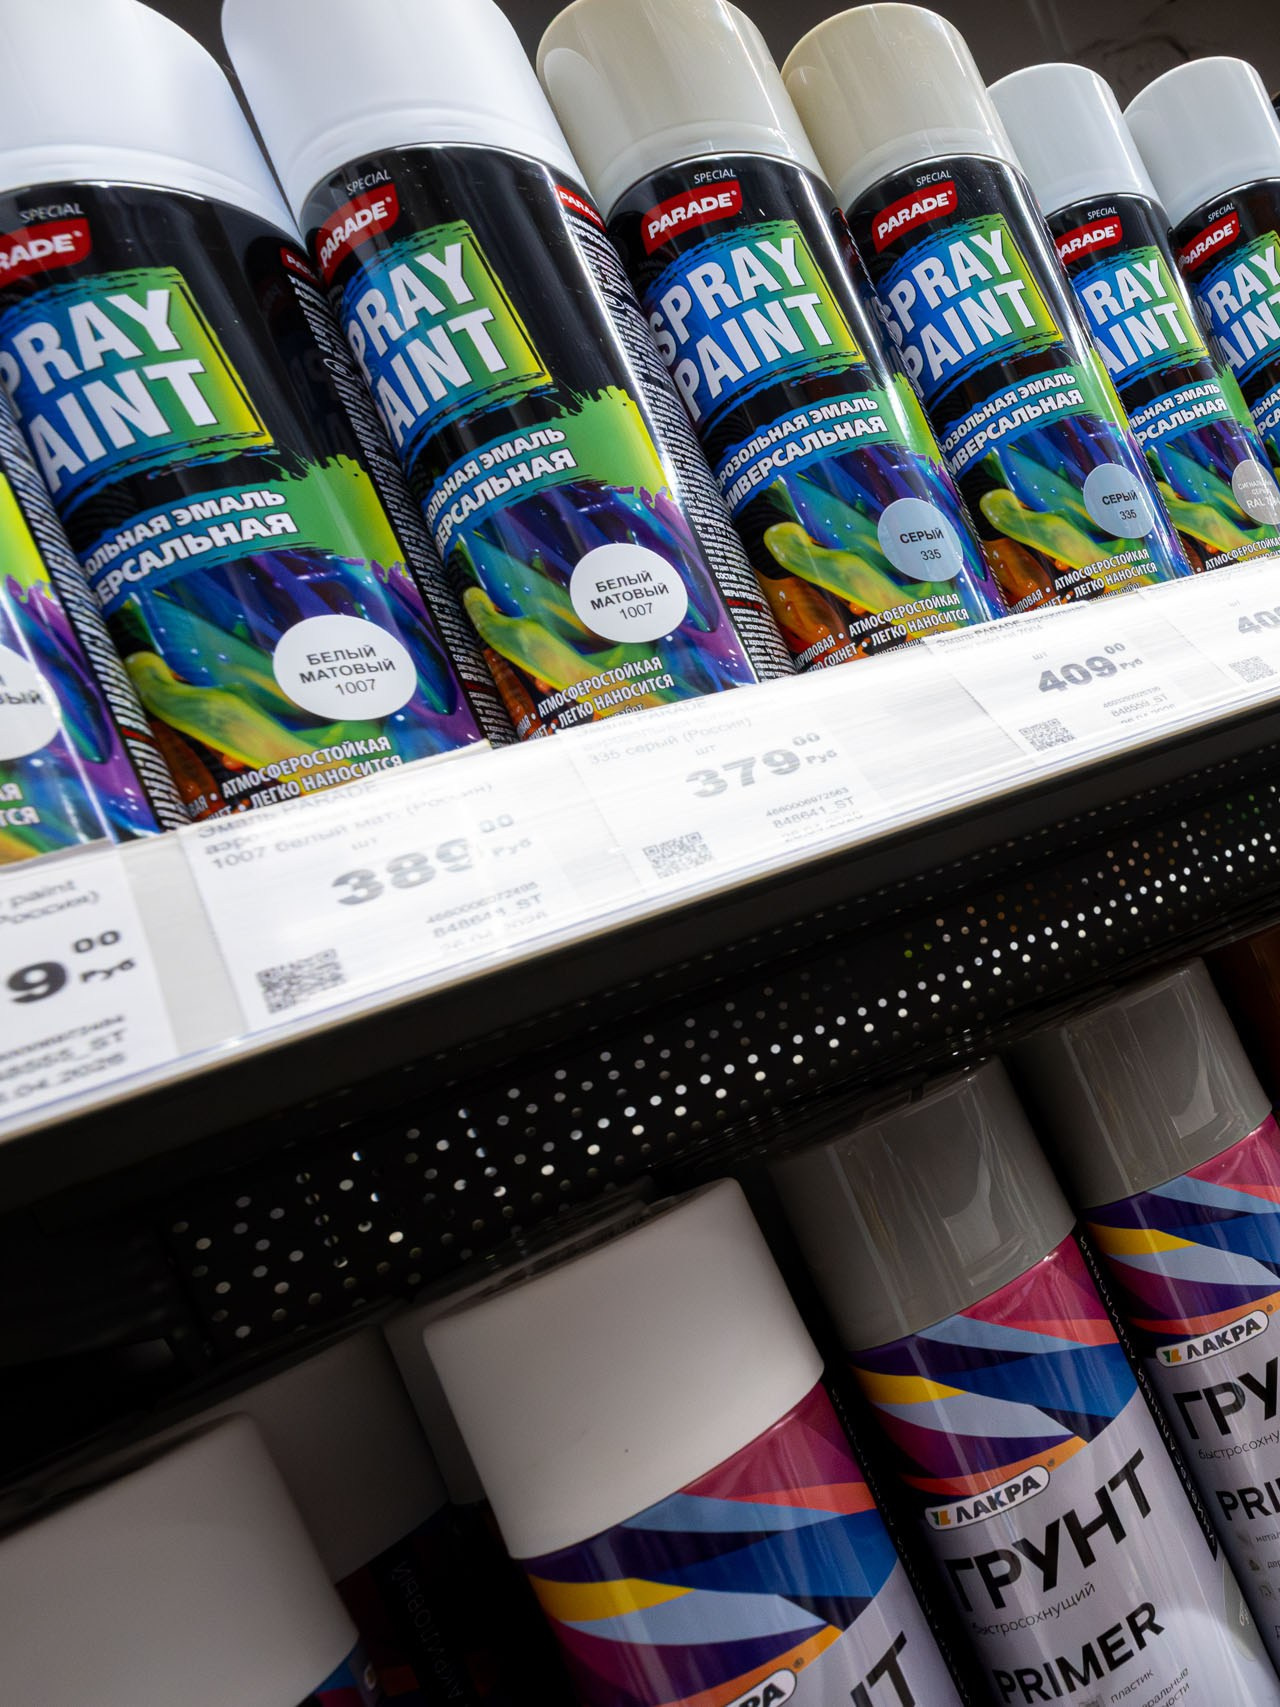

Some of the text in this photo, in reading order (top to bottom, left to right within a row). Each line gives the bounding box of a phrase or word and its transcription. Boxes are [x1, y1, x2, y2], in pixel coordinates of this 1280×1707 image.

[345, 169, 392, 197] SPECIAL
[694, 168, 736, 185] SPECIAL
[916, 170, 952, 187] SPECIAL
[20, 203, 84, 223] SPECIAL
[648, 191, 734, 240] PARADE
[877, 192, 949, 239] PARADE
[1087, 207, 1118, 220] SPECIAL
[1208, 202, 1236, 223] SPECIAL
[319, 200, 390, 267] PARADE
[649, 237, 806, 362] SPRAY
[1082, 259, 1168, 326] RAY
[674, 292, 833, 422] PAINT
[903, 279, 1036, 398] PAINT
[378, 307, 508, 449] AINT
[1018, 371, 1076, 399] ЭМАЛЬ
[1175, 384, 1222, 405] ЭМАЛЬ
[28, 358, 219, 494] AINT
[811, 396, 879, 425] ЭМАЛЬ
[482, 428, 567, 467] ЭМАЛЬ
[174, 489, 287, 526] ЭМАЛЬ
[1101, 490, 1139, 507] СЕРЫЙ
[1119, 508, 1137, 521] 335
[899, 526, 944, 545] СЕРЫЙ
[920, 548, 942, 561] 335
[595, 570, 653, 593] БЕЛЫЙ
[1054, 548, 1150, 591] АТМОСФЕРОСТОЙКАЯ
[1074, 580, 1104, 600] ЛЕГКО
[1104, 561, 1158, 585] НАНОСИТСЯ
[590, 584, 669, 611] МАТОВЫЙ
[618, 602, 654, 620] 1007
[848, 593, 960, 639] АТМОСФЕРОСТОЙКАЯ
[871, 607, 970, 648] ЛЕГКО НАНОСИТСЯ
[299, 657, 397, 686] МАТОВЫЙ
[306, 644, 377, 666] БЕЛЫЙ
[1037, 642, 1127, 694] 409 00
[334, 678, 377, 697] 1007
[537, 656, 663, 718] АТМОСФЕРОСТОЙКАЯ
[558, 702, 595, 729] ЛЕГКО
[594, 673, 675, 711] НАНОСИТСЯ
[222, 736, 392, 798] АТМОСФЕРОСТОЙКАЯ
[250, 780, 301, 810] ЛЕГКО
[301, 754, 402, 793] НАНОСИТСЯ
[684, 732, 821, 798] 379 00
[330, 837, 475, 907] 389
[70, 929, 123, 955] 00
[1187, 1316, 1263, 1360] ЛАКРА
[955, 1475, 1042, 1524] ЛАКРА
[944, 1448, 1153, 1614] ГРУНТ
[992, 1602, 1165, 1706] PRIMER
[1109, 1669, 1154, 1704] пластик
